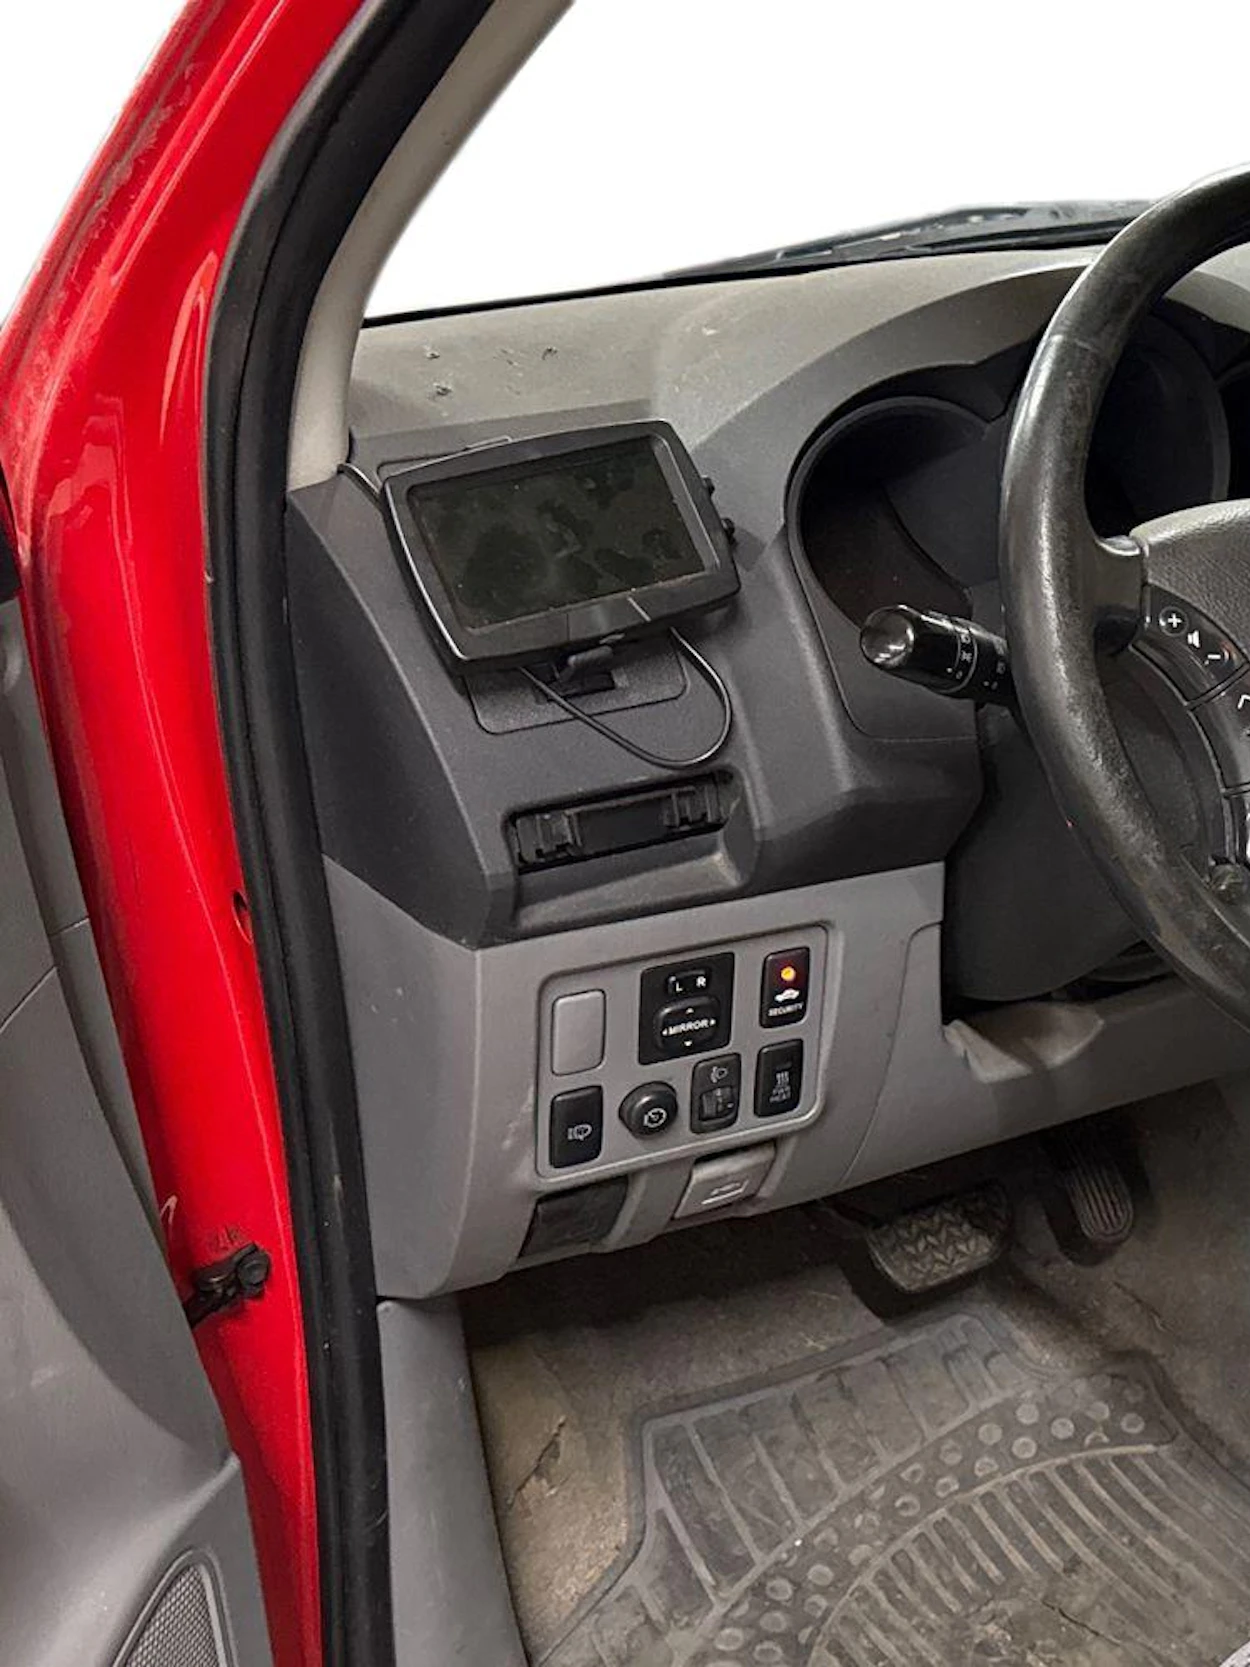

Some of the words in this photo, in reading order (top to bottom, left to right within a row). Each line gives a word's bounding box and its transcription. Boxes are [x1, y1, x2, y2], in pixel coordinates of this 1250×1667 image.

[675, 982, 682, 992] L
[696, 976, 706, 987] R
[768, 1003, 803, 1017] SECURITY
[669, 1019, 709, 1035] MIRROR
